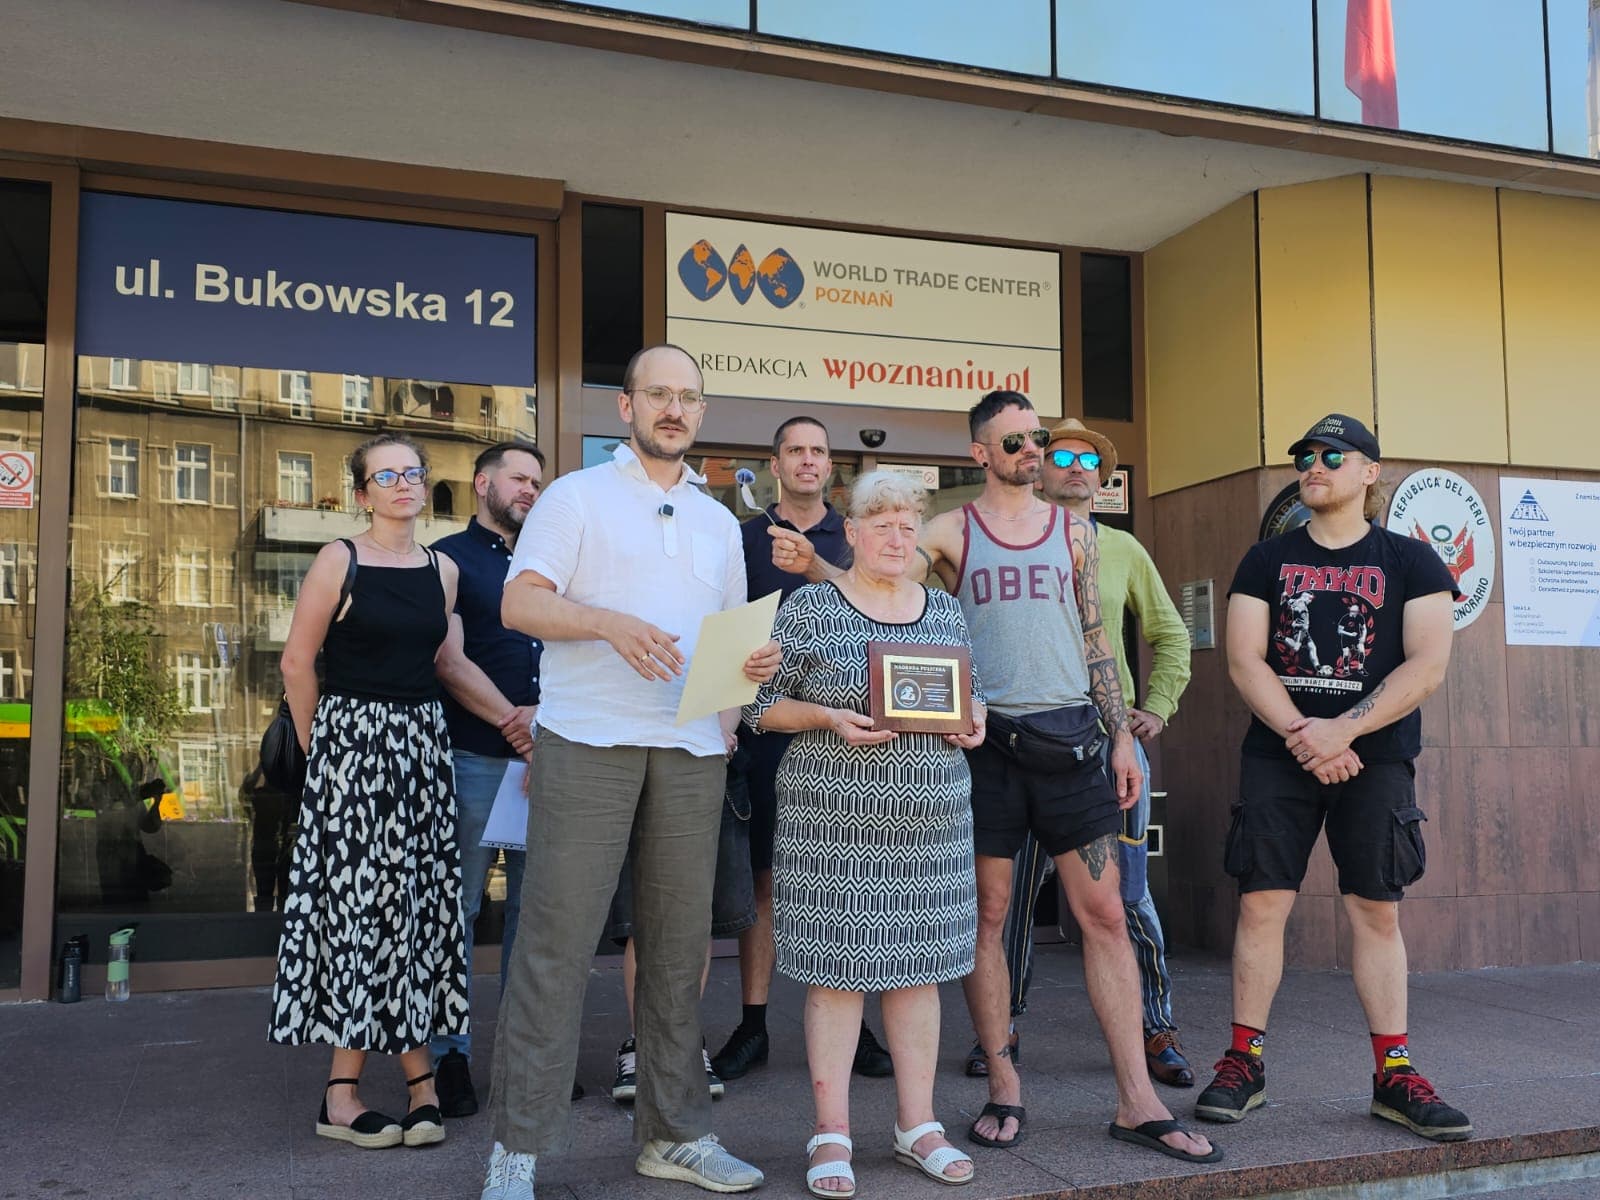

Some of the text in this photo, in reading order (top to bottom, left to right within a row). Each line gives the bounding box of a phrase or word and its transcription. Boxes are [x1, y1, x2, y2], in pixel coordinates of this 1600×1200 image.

[115, 259, 515, 328] ul. Bukowska 12
[813, 260, 888, 284] WORLD
[893, 268, 959, 291] TRADE
[815, 286, 893, 308] POZNAŃ
[700, 353, 1030, 394] REDAKCJA wpoznaniu.pl
[1393, 475, 1486, 527] REPUBLICA DEL PERU
[1508, 527, 1555, 538] Twój partner
[1517, 540, 1567, 552] bezpiecznym
[1568, 544, 1597, 552] rozwoju
[970, 565, 1069, 605] OBEY
[1279, 563, 1386, 609] TNWD
[1453, 577, 1489, 621] ONORARIO
